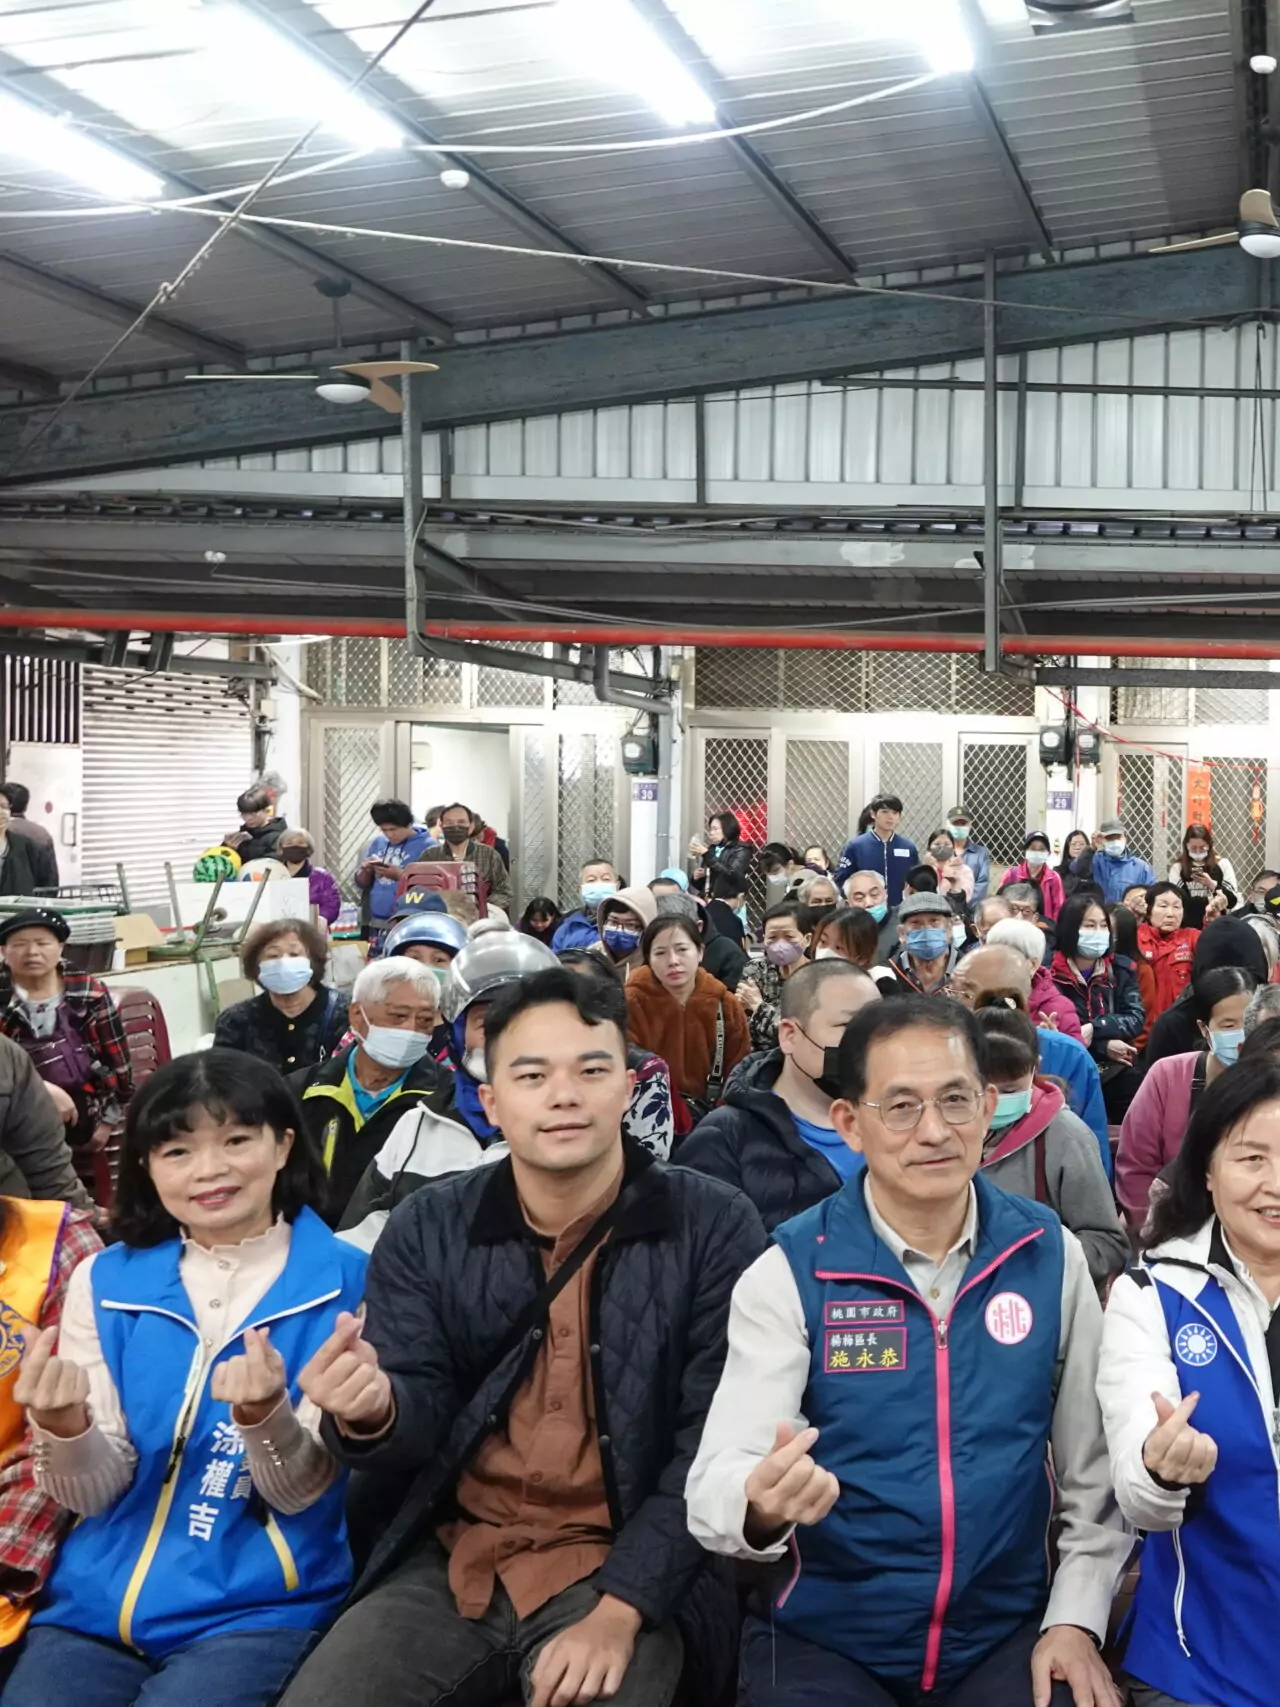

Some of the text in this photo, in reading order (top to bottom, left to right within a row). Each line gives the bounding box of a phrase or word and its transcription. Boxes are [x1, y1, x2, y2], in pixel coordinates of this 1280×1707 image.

[641, 789, 654, 800] 30
[1054, 798, 1067, 809] 29
[405, 892, 425, 904] W
[831, 1304, 899, 1320] 桃園市政府
[830, 1332, 878, 1347] 楊梅區長
[829, 1347, 900, 1368] 施永恭
[187, 1420, 245, 1542] 涂權吉
